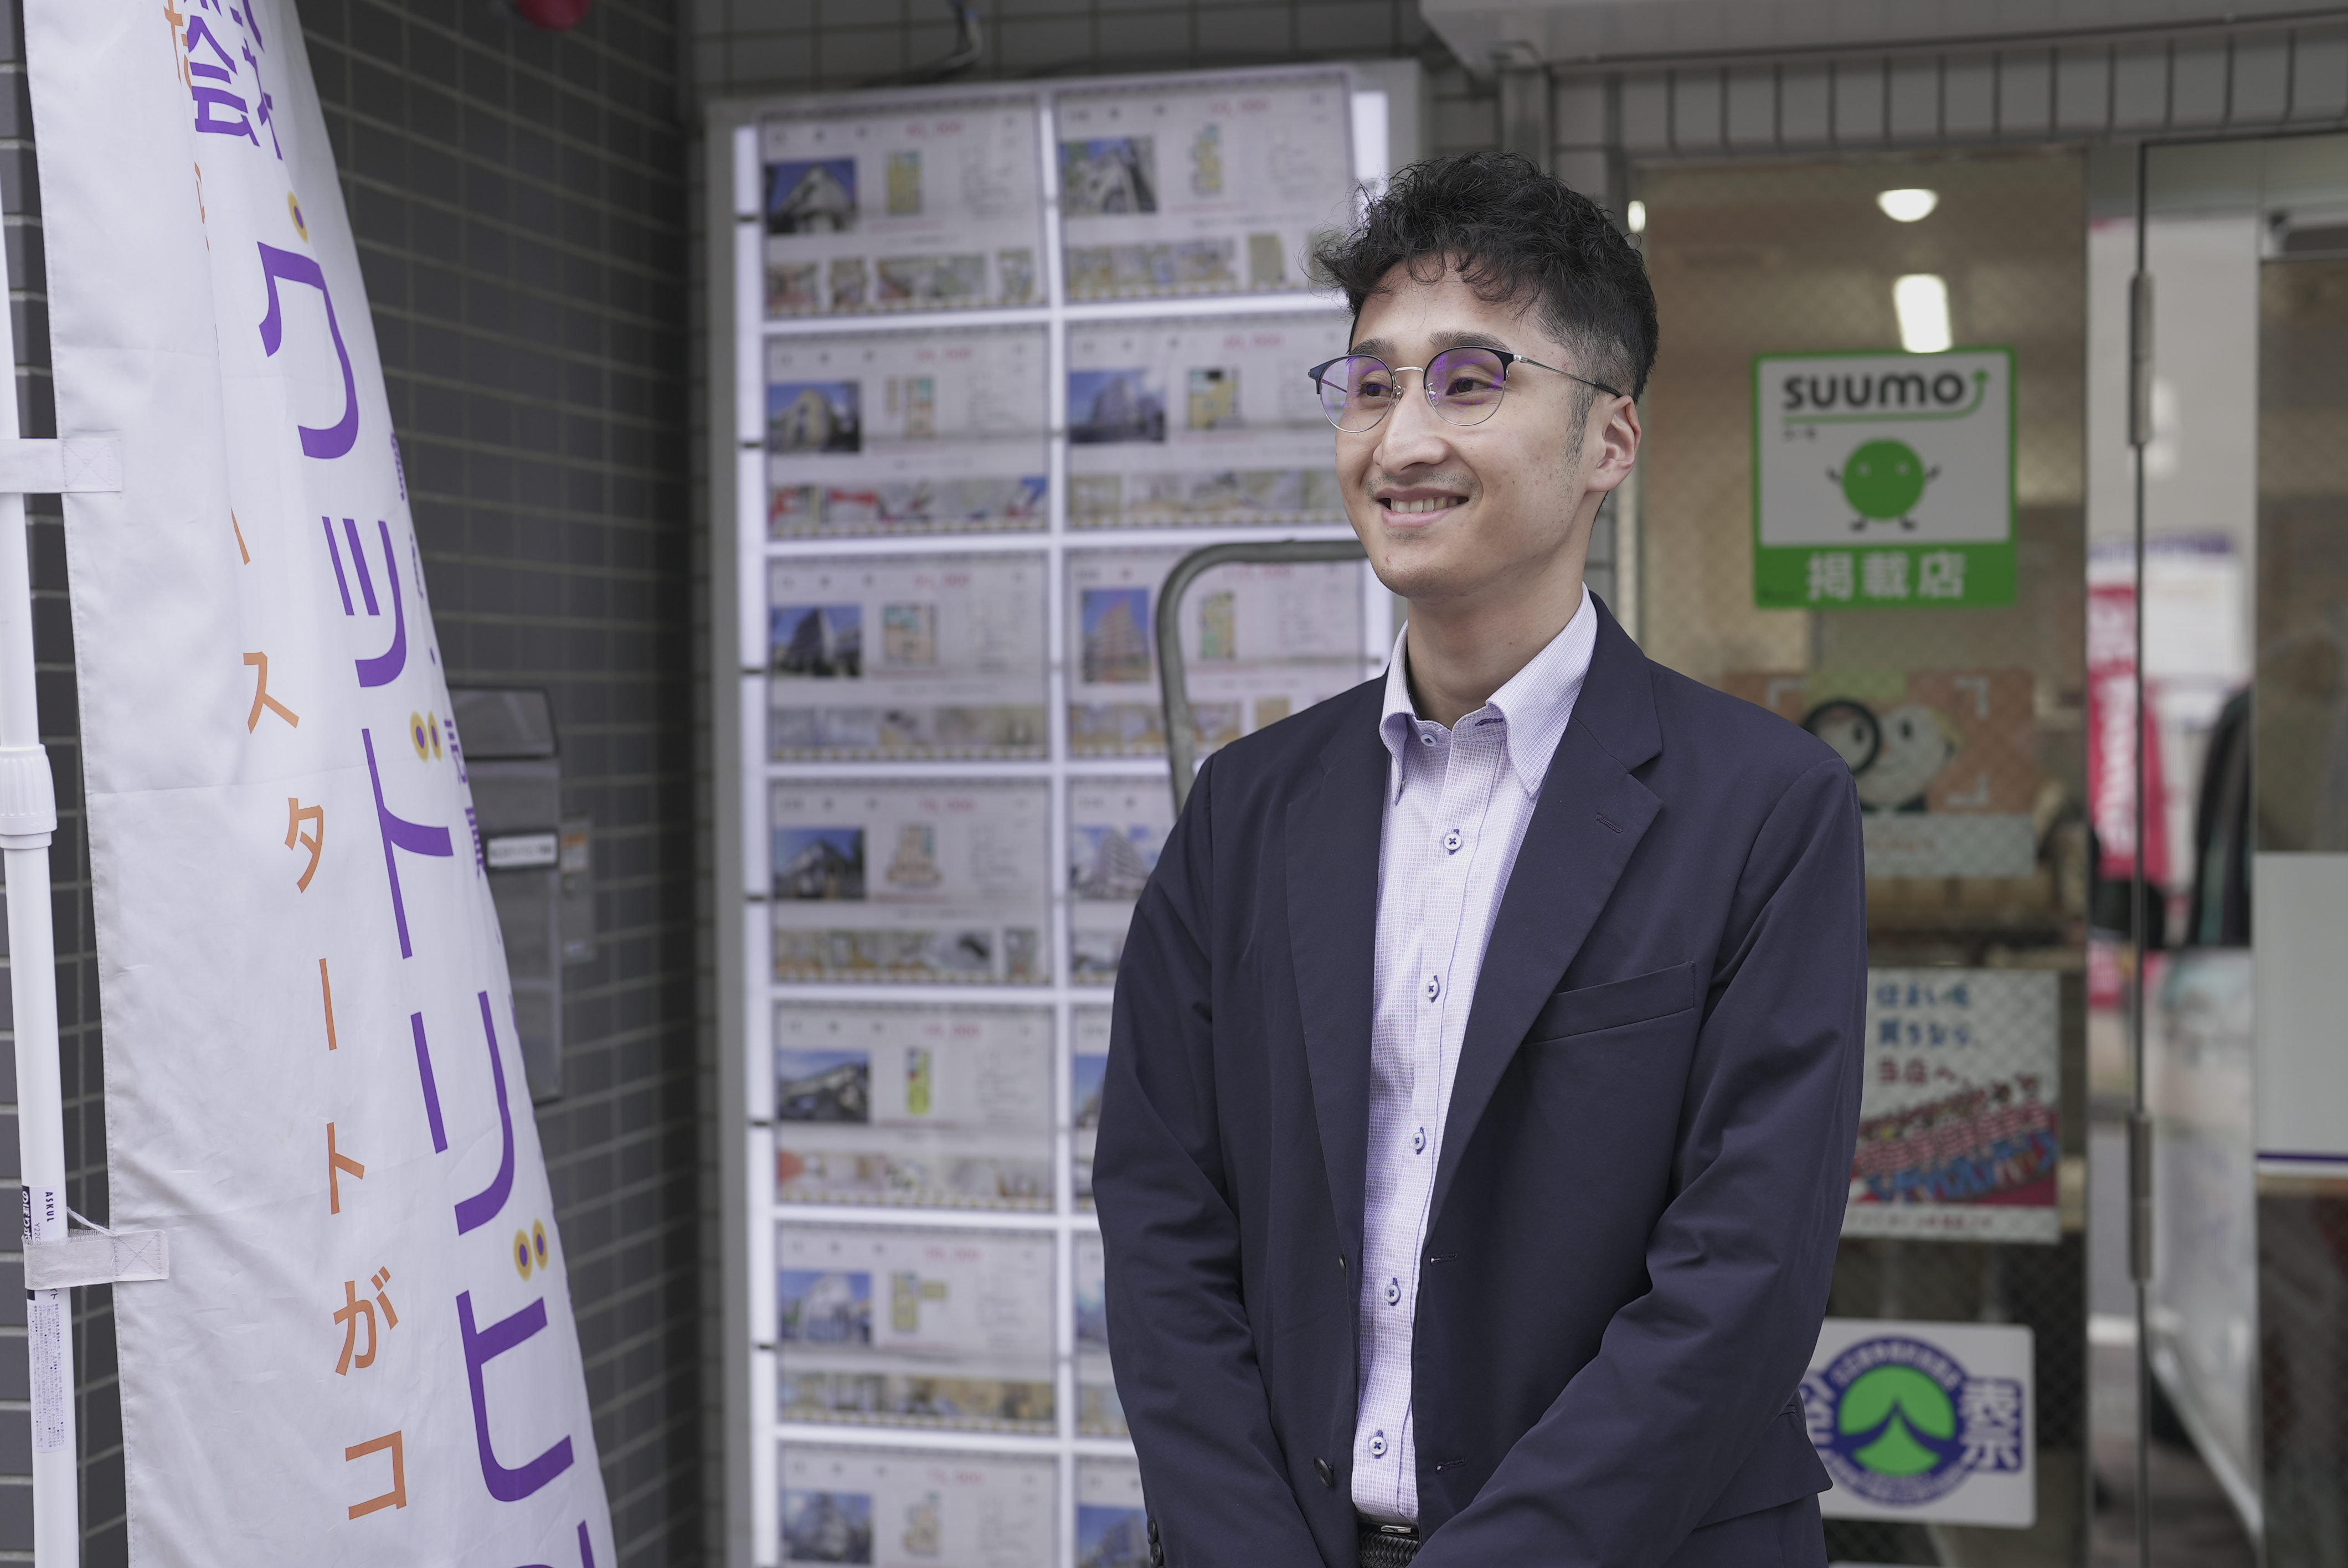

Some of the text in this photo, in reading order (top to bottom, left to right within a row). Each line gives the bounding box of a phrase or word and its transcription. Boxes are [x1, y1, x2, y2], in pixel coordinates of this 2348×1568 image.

[1806, 549, 1966, 601] 掲載店
[256, 190, 596, 1568] グッドリビ
[45, 1192, 54, 1222] ASKUL
